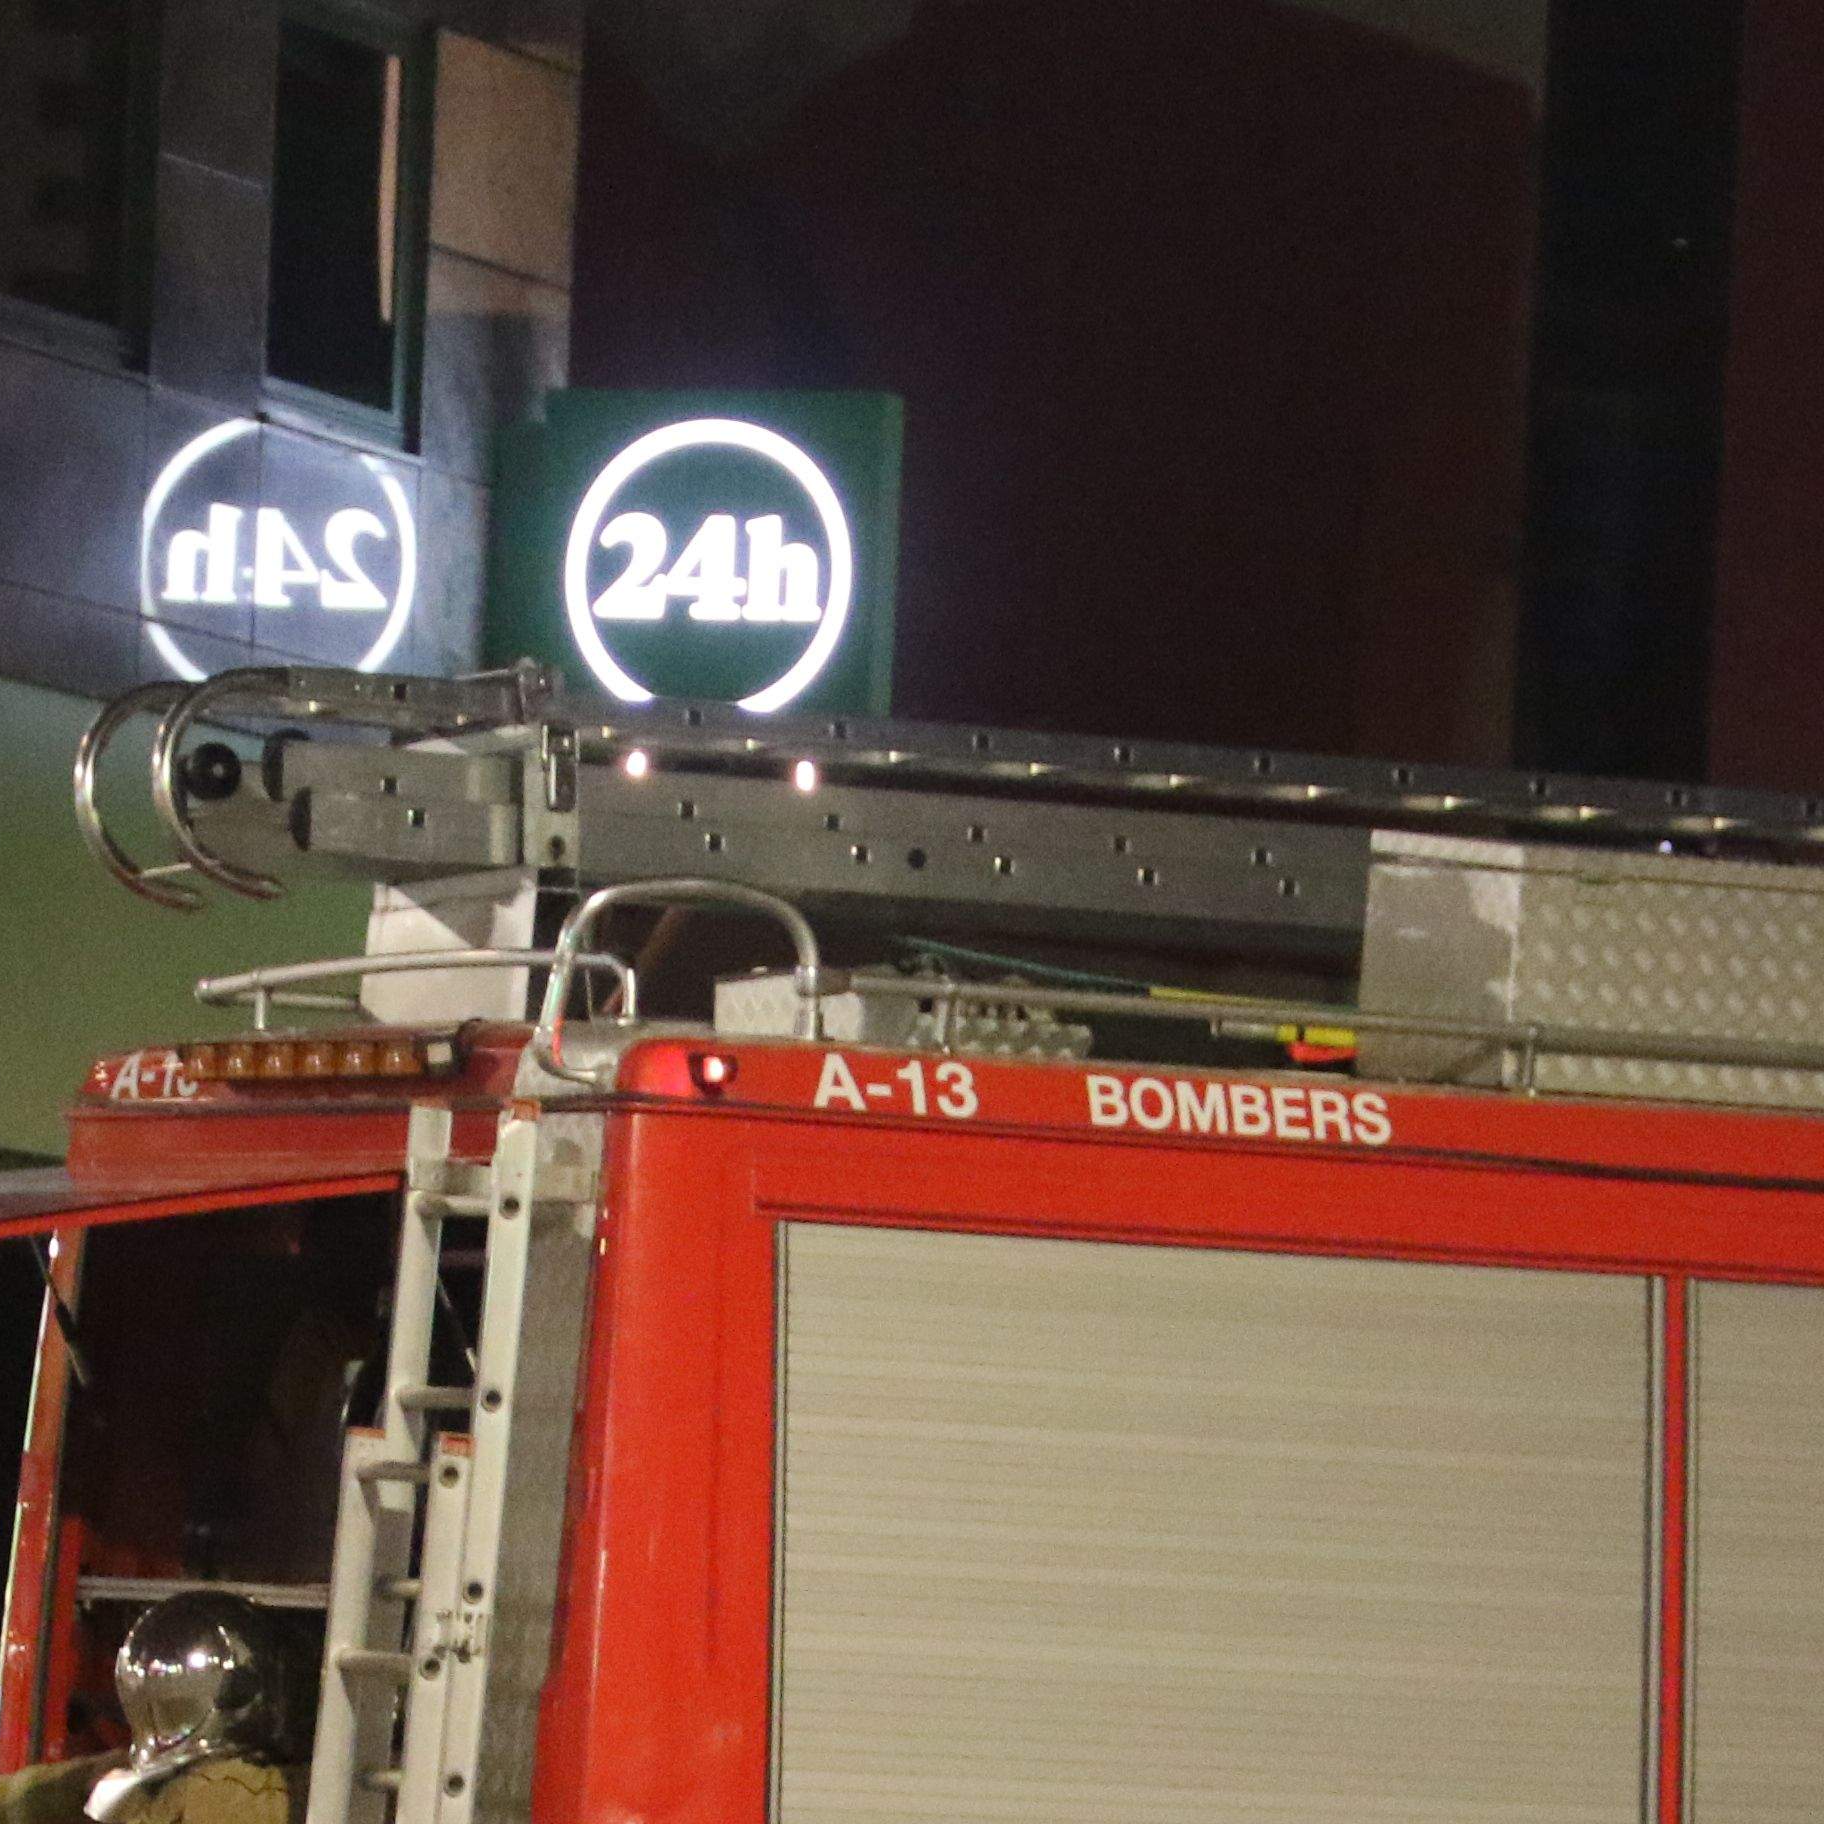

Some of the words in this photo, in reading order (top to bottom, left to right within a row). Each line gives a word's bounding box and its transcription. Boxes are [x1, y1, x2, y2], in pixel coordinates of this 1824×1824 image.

[593, 511, 824, 623] 24h
[812, 1053, 979, 1119] A-13
[1086, 1074, 1393, 1145] BOMBERS
